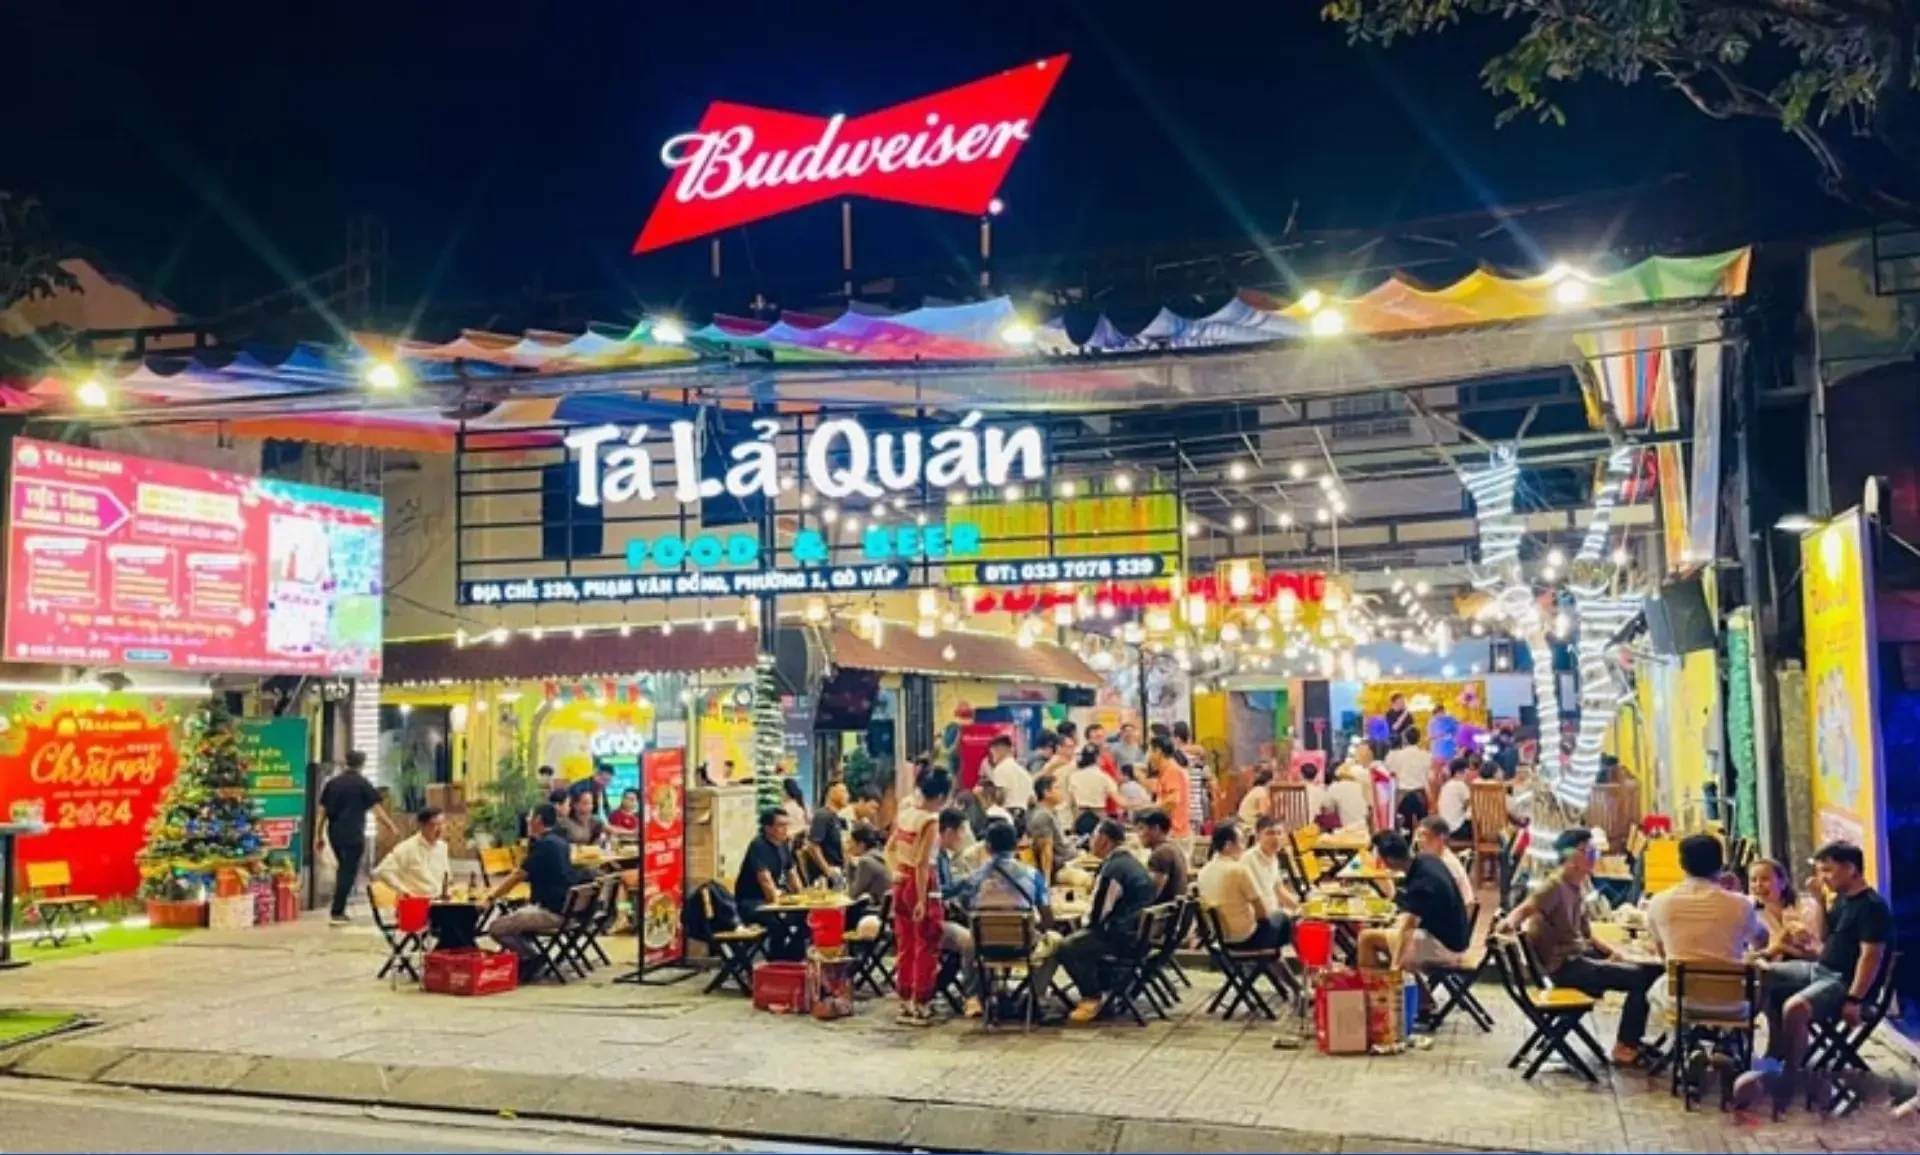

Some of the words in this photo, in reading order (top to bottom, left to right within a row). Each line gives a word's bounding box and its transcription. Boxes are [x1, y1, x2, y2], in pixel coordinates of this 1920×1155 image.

[661, 112, 1031, 203] Budweiser
[564, 420, 656, 505] Tá
[669, 418, 781, 503] Lả
[806, 410, 1046, 499] Quán
[625, 533, 759, 569] FOOD
[793, 528, 828, 562] &
[863, 523, 982, 560] BEER
[1021, 561, 1058, 580] 033
[1062, 559, 1112, 578] 7078
[30, 741, 163, 786] Christmas
[59, 799, 133, 829] 2024
